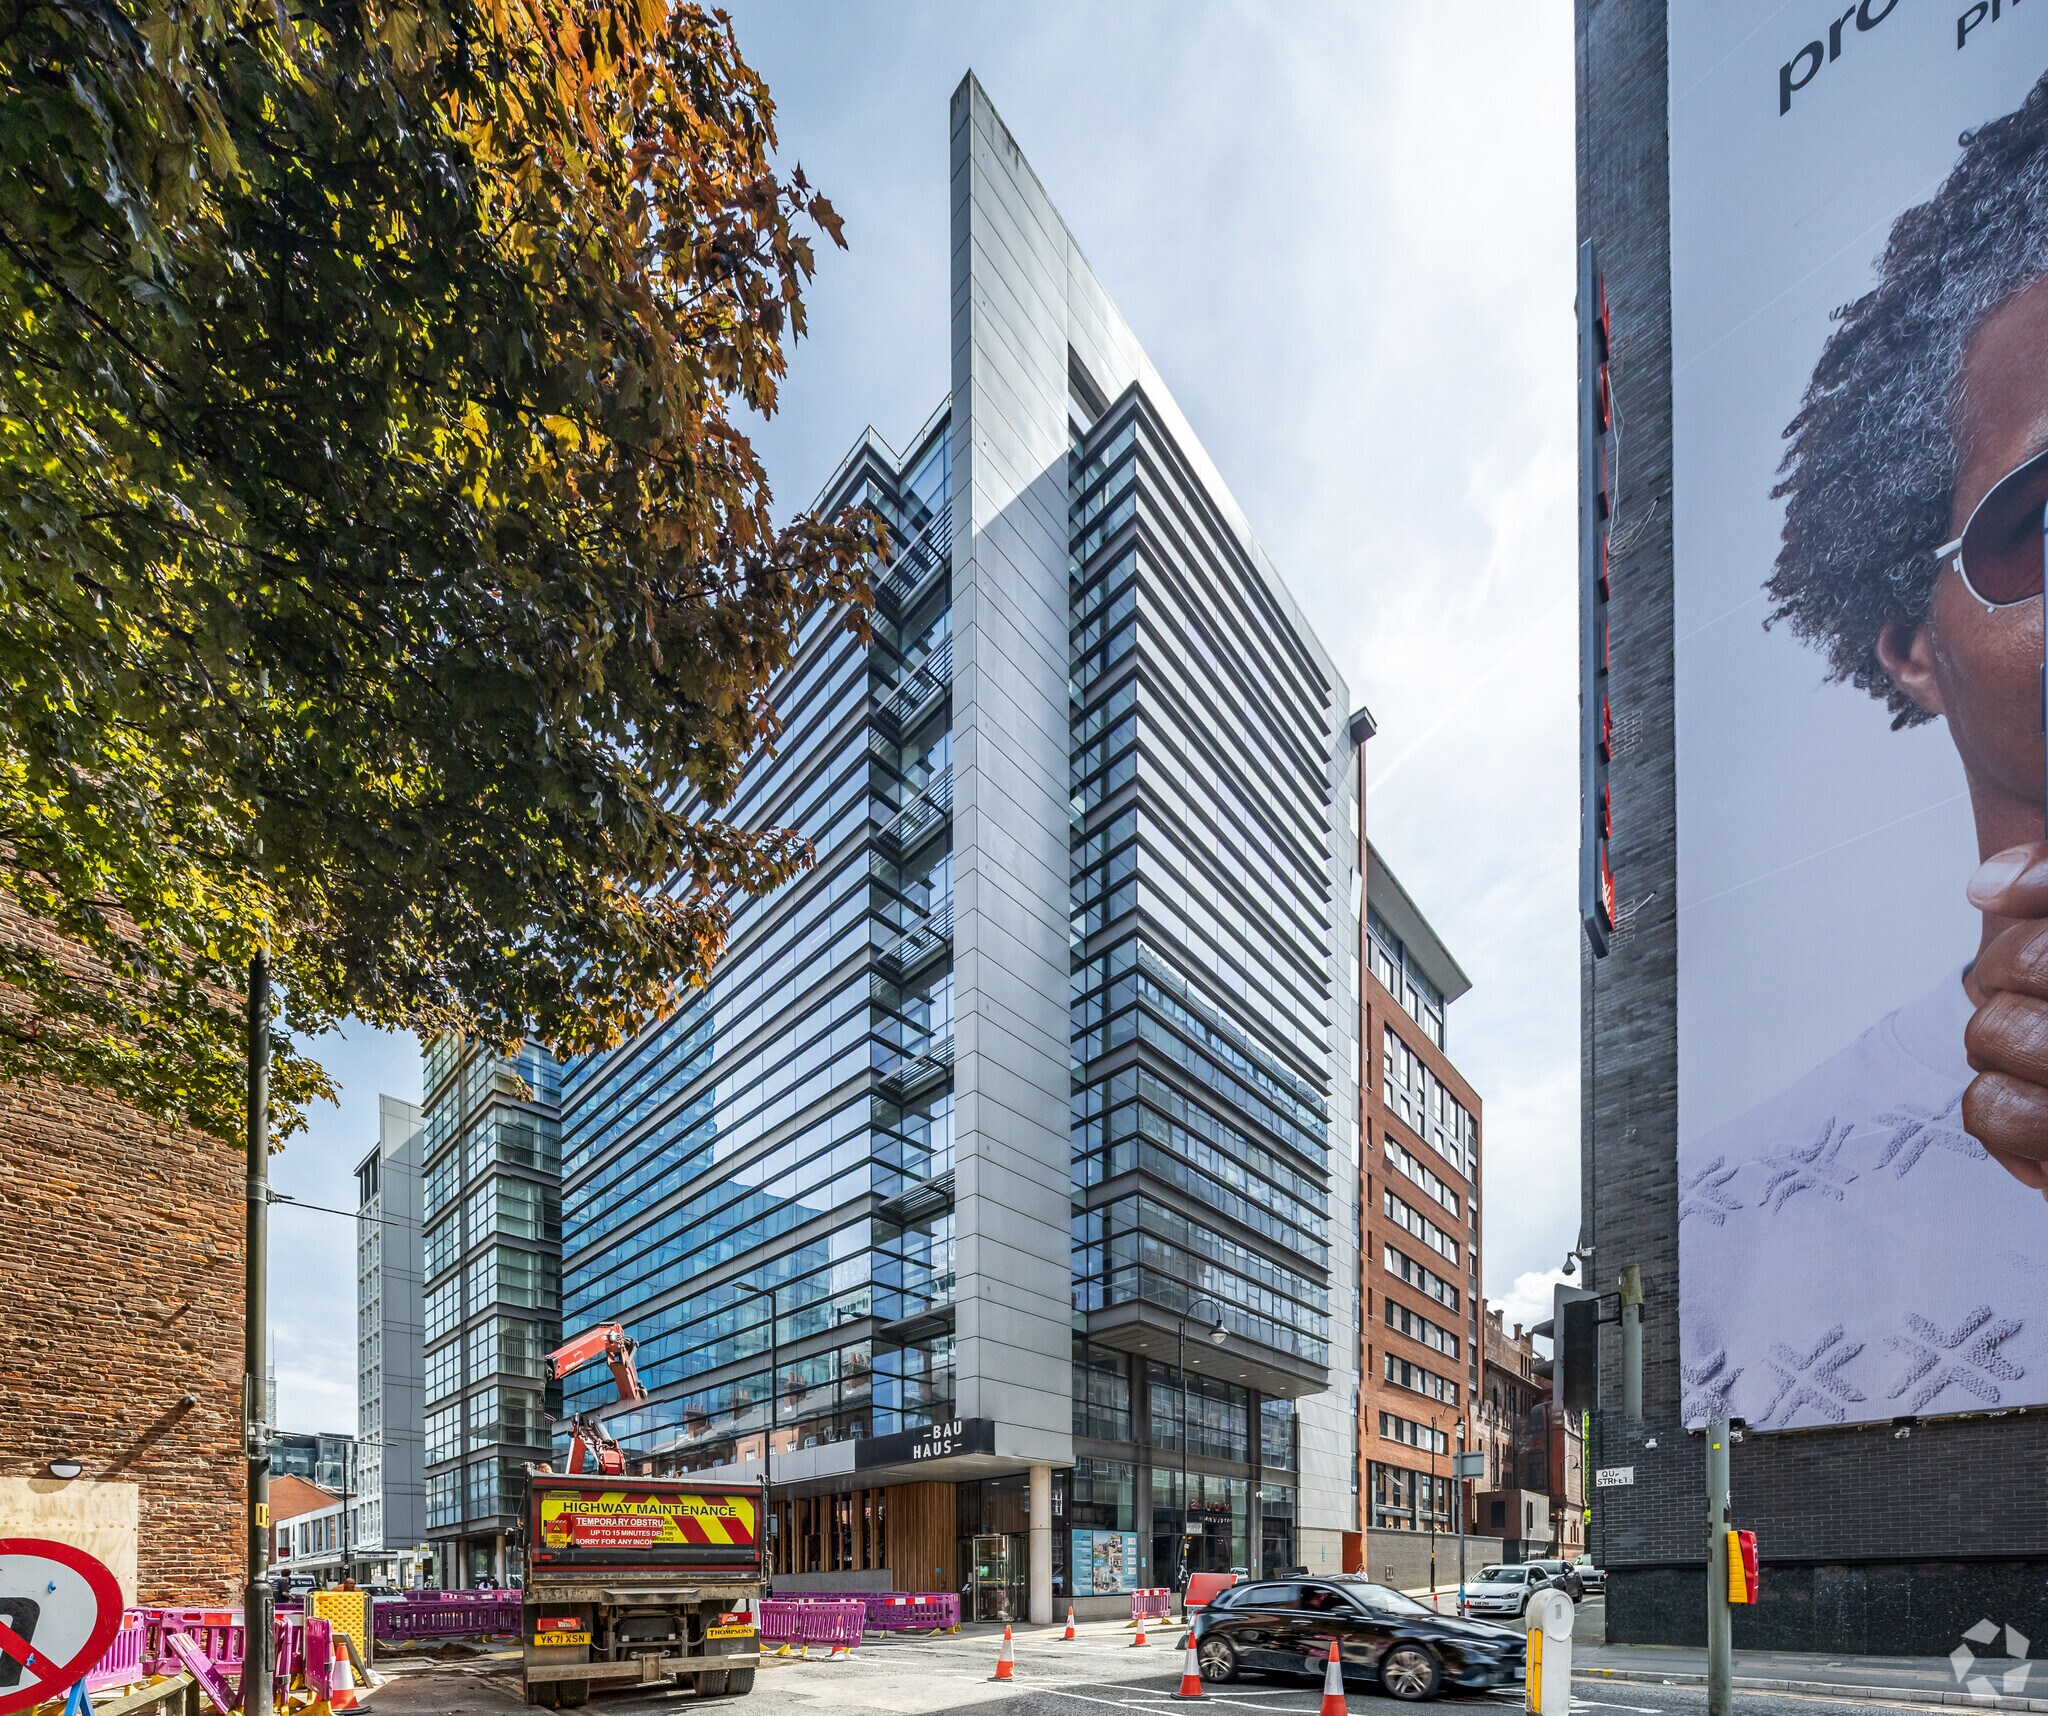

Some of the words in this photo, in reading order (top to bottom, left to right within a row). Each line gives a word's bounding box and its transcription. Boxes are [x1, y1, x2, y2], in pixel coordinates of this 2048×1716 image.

[563, 1502, 632, 1513] HIGHWAY
[637, 1504, 737, 1516] MAINTENANCE
[576, 1517, 629, 1526] TEMPORARY
[630, 1518, 665, 1527] OBSTRU
[541, 1635, 562, 1643] YK71
[566, 1635, 585, 1643] XSN
